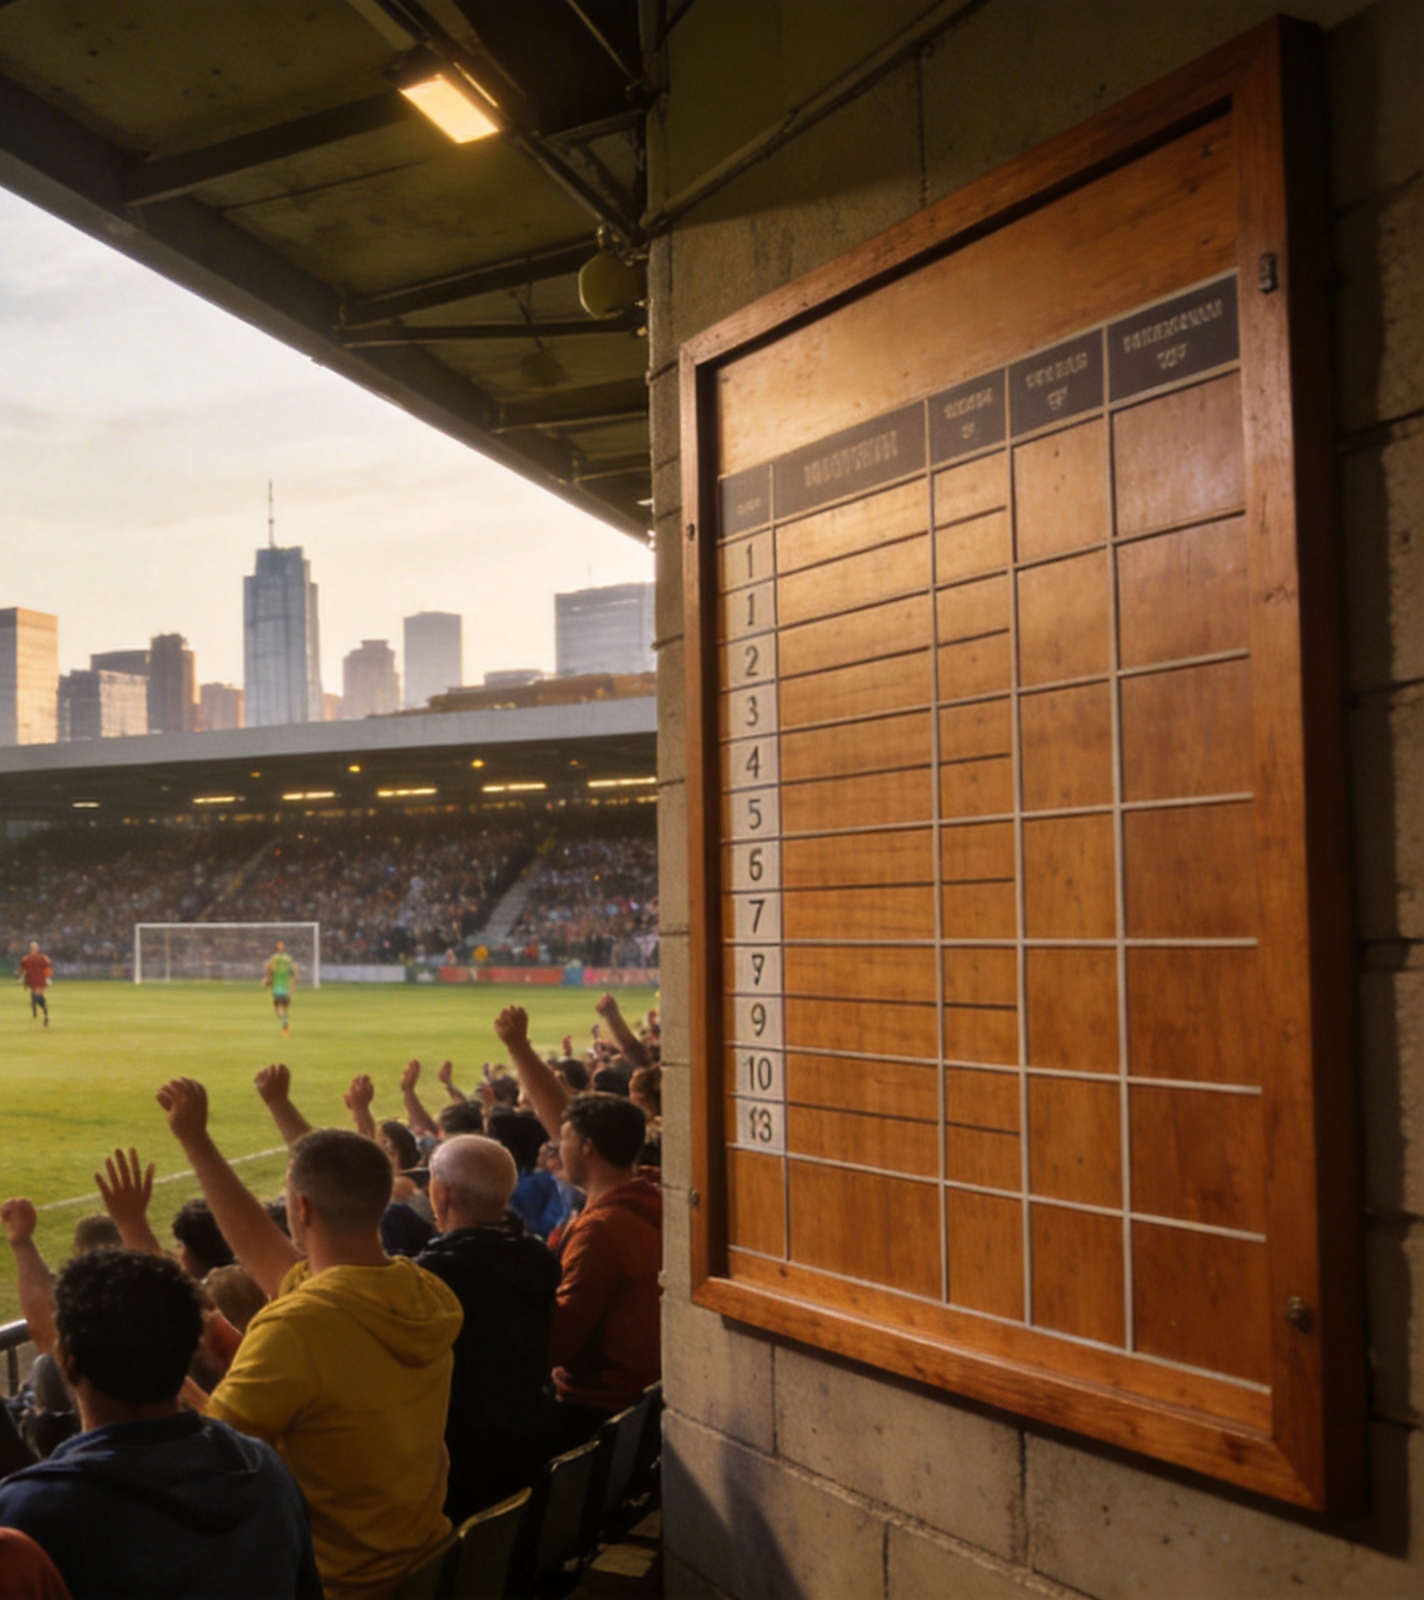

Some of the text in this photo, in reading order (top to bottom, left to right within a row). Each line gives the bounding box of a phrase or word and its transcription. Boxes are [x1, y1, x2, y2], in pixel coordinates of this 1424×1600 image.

[745, 645, 759, 677] 2
[745, 695, 760, 727] 3
[746, 745, 760, 779] 4
[748, 798, 762, 830] 5
[749, 849, 763, 882] 6
[748, 898, 765, 934] 7
[751, 1002, 766, 1038] 9
[744, 1055, 773, 1092] 10
